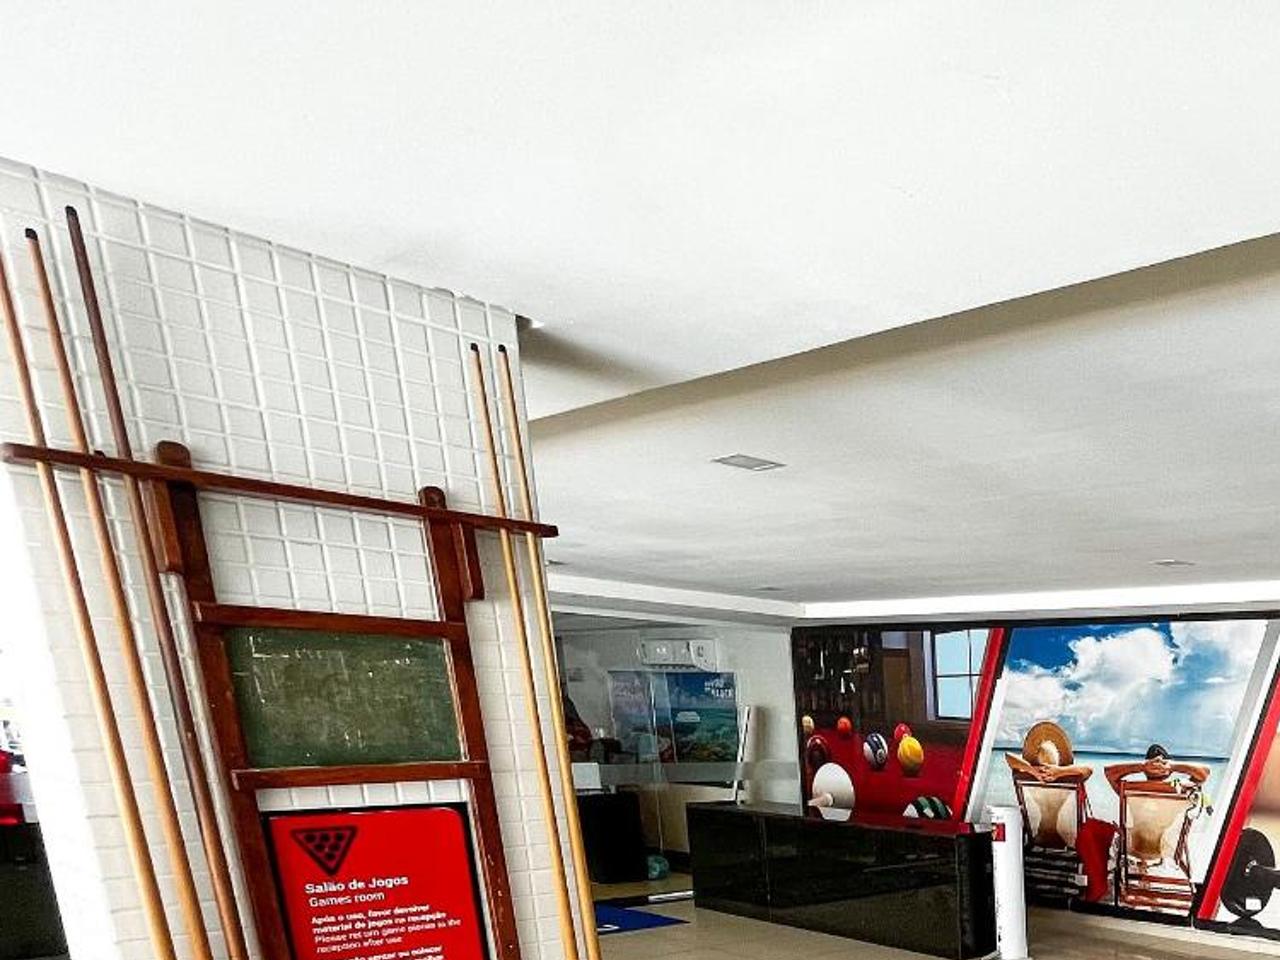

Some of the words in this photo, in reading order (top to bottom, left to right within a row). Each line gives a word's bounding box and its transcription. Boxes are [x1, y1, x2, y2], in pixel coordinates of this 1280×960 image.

[304, 881, 345, 894] Salão
[348, 878, 365, 890] de
[368, 875, 409, 890] Jogos
[309, 895, 352, 907] Games
[354, 893, 385, 902] room
